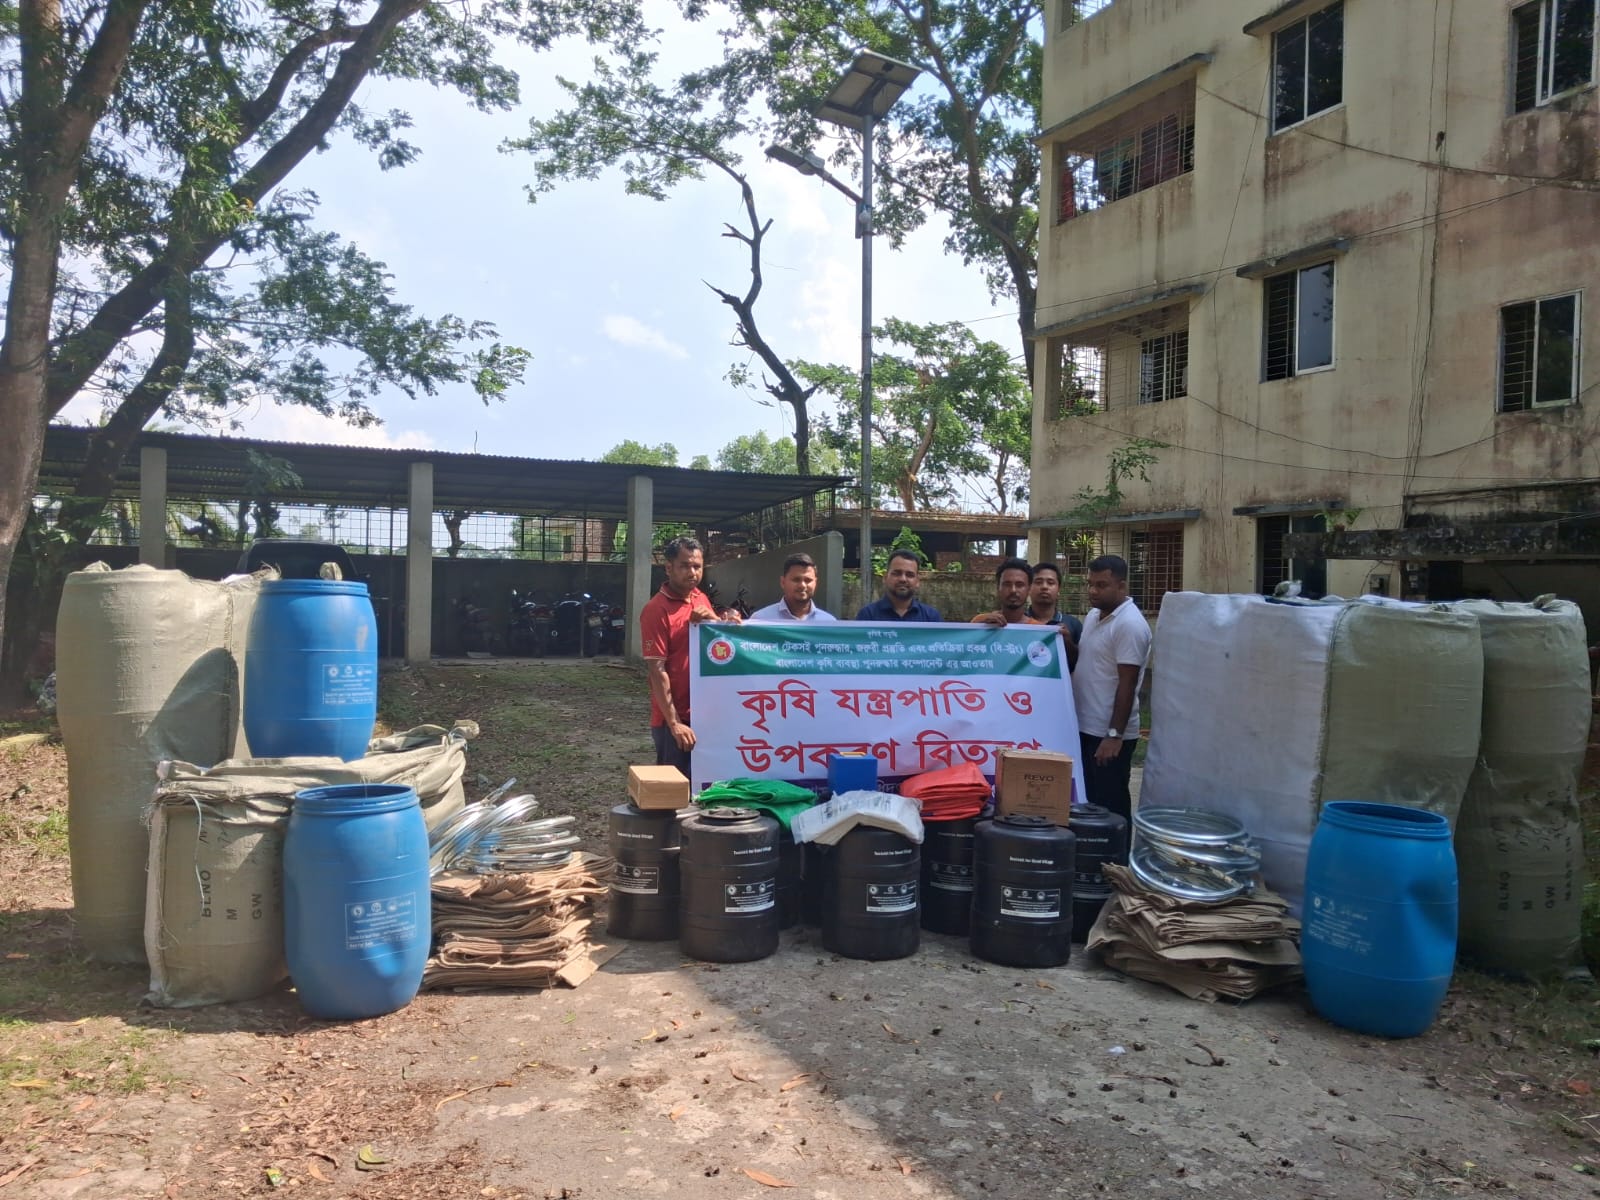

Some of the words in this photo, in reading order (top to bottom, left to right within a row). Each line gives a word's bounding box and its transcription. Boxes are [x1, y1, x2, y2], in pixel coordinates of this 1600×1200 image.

[739, 640, 779, 653] বাংলাদেশ
[782, 640, 812, 653] টেকসই
[775, 658, 814, 669] বাংলাদেশ
[816, 657, 833, 672] কৃষি
[737, 679, 818, 733] কৃষি
[830, 680, 987, 719] যন্ত্রপাতি
[1003, 691, 1033, 716] ও
[912, 729, 1043, 770] বিত
[252, 893, 263, 920] GW
